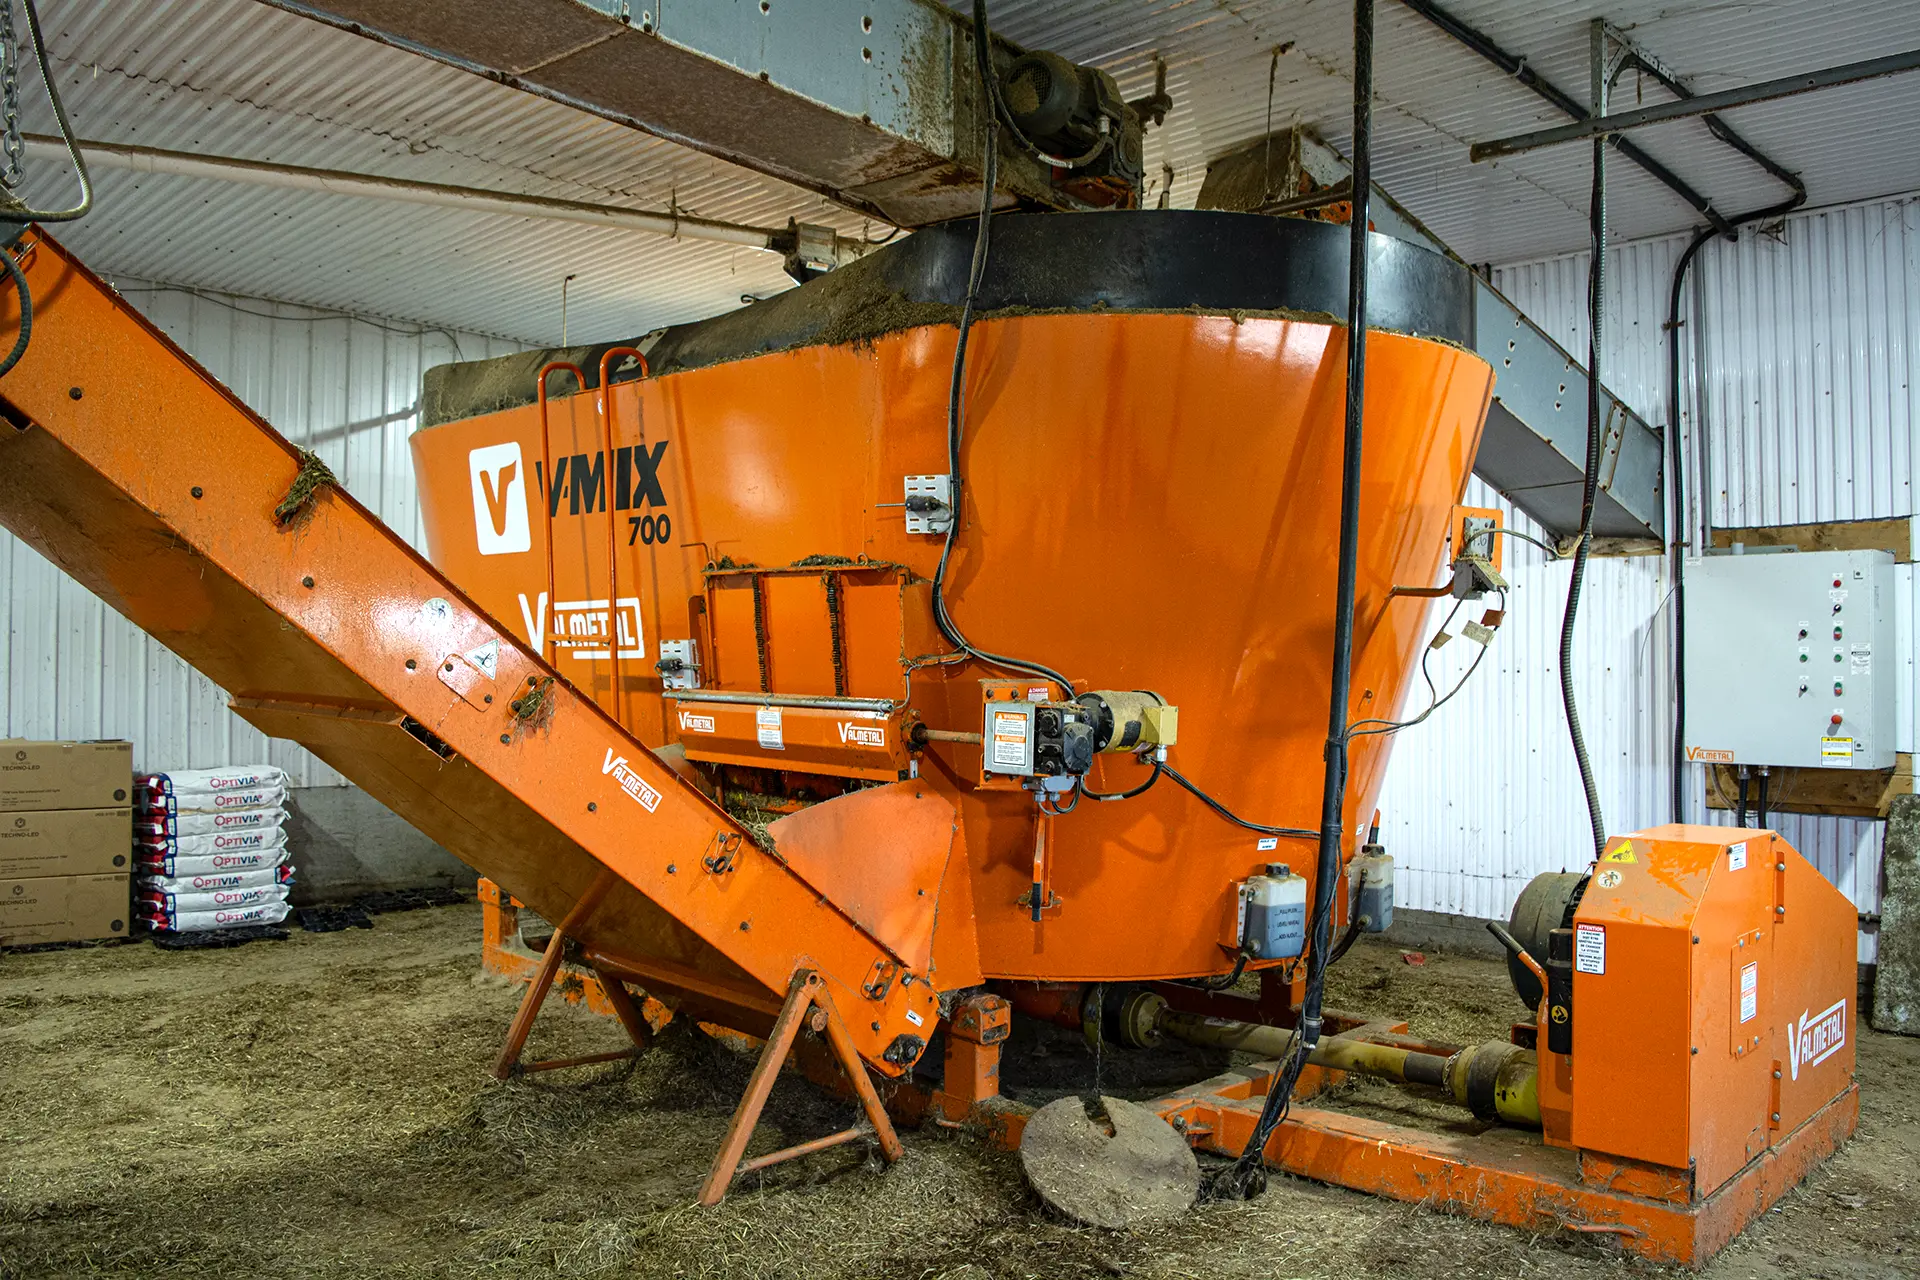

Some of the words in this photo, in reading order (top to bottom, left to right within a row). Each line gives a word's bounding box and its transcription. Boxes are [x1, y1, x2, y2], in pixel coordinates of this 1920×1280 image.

[535, 440, 669, 518] V-MIX
[628, 513, 671, 546] 700
[678, 711, 713, 731] VALMETAL
[837, 721, 882, 744] VALMETAL
[1685, 745, 1732, 762] VALMETAL
[210, 776, 256, 788] OPTIVIA
[601, 747, 657, 809] VALMETAL
[215, 795, 260, 807] OPTIVIA
[215, 815, 260, 826] OPTIVIA
[215, 835, 260, 847] OPTIVIA
[213, 855, 258, 867] OPTIVIA
[193, 877, 239, 888] OPTIVIA
[214, 892, 260, 904] OPTIVIA
[215, 910, 261, 921] OPTIVIA
[1578, 924, 1604, 932] ATTENTION
[1787, 1007, 1844, 1081] VALMETAL
